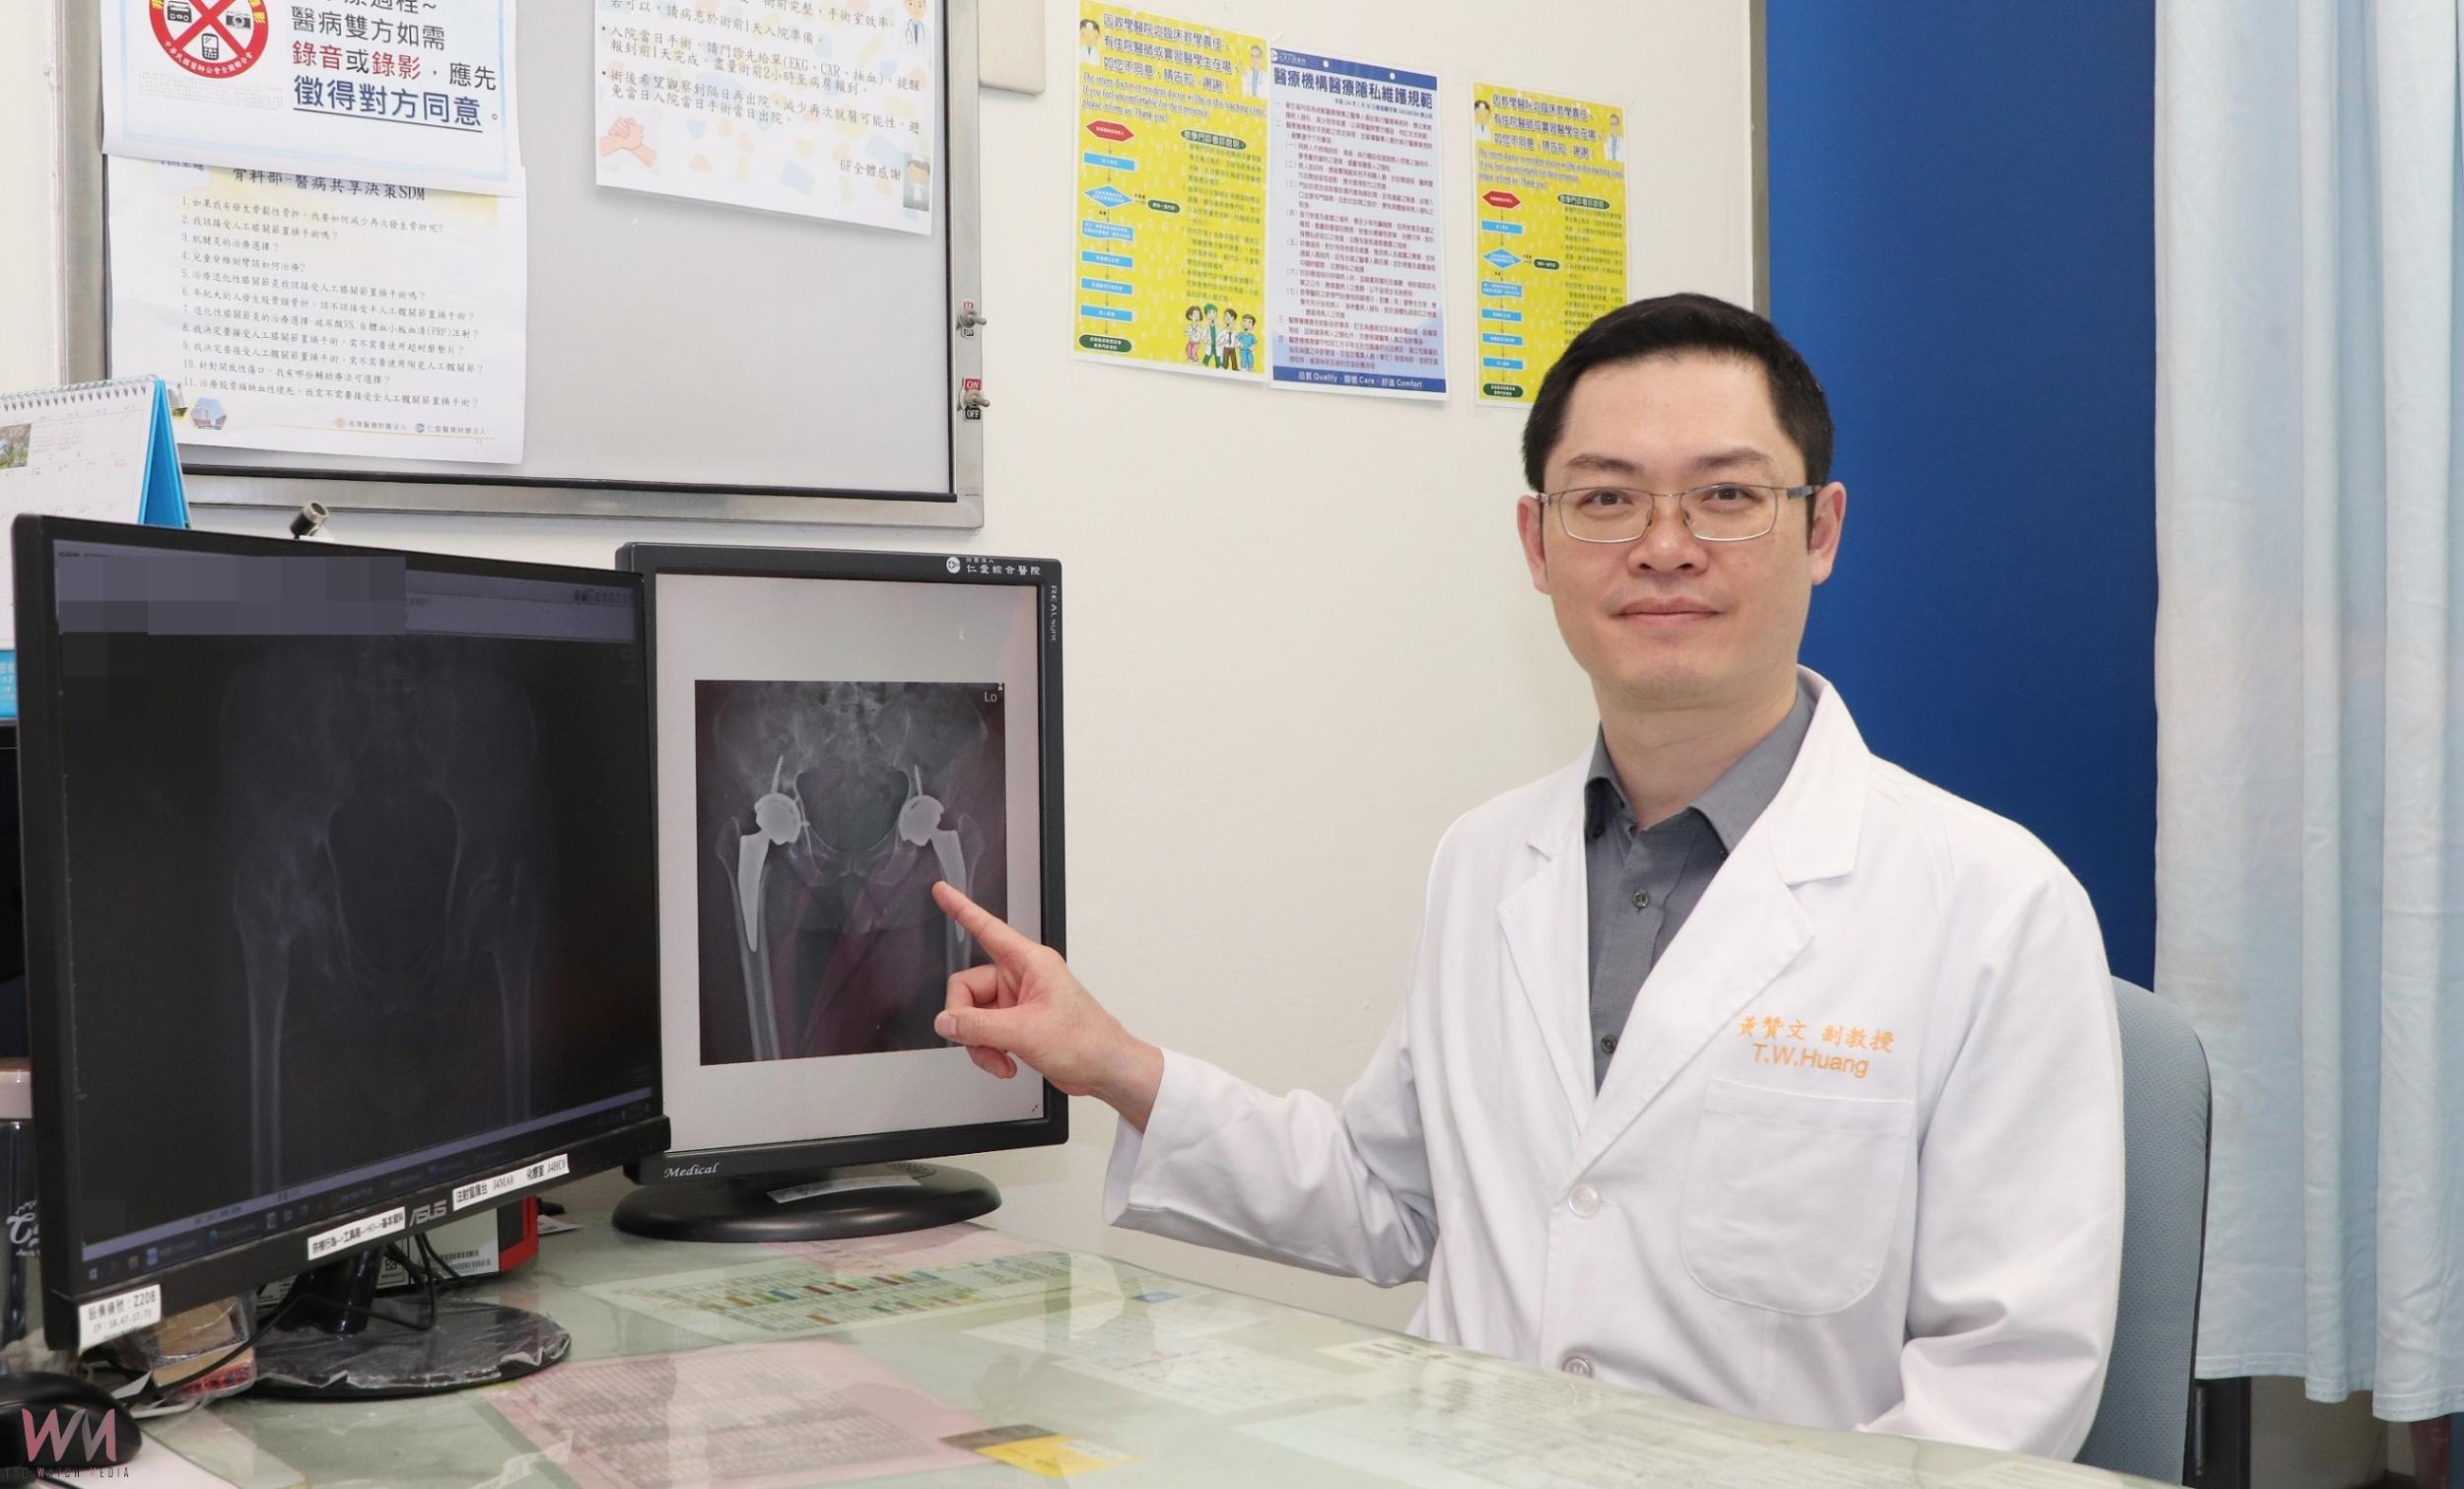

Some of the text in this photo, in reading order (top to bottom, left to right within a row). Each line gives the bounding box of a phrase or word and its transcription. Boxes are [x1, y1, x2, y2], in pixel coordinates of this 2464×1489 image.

[292, 6, 445, 51] 醫病雙方如需
[294, 75, 499, 126] 徵得對方同意。
[1273, 67, 1433, 109] 醫療機構醫療隱私維護規範
[966, 380, 980, 389] ON
[1314, 372, 1337, 383] Quality
[1359, 375, 1375, 384] Care
[1396, 378, 1423, 388] Comfort
[966, 410, 980, 419] OFF
[966, 564, 1041, 576] 仁愛綜合醫院
[1821, 1025, 1895, 1053] 副教授
[1752, 1043, 1870, 1079] T.W.Huang
[663, 1162, 720, 1179] Medical
[409, 1199, 447, 1228] ASUS
